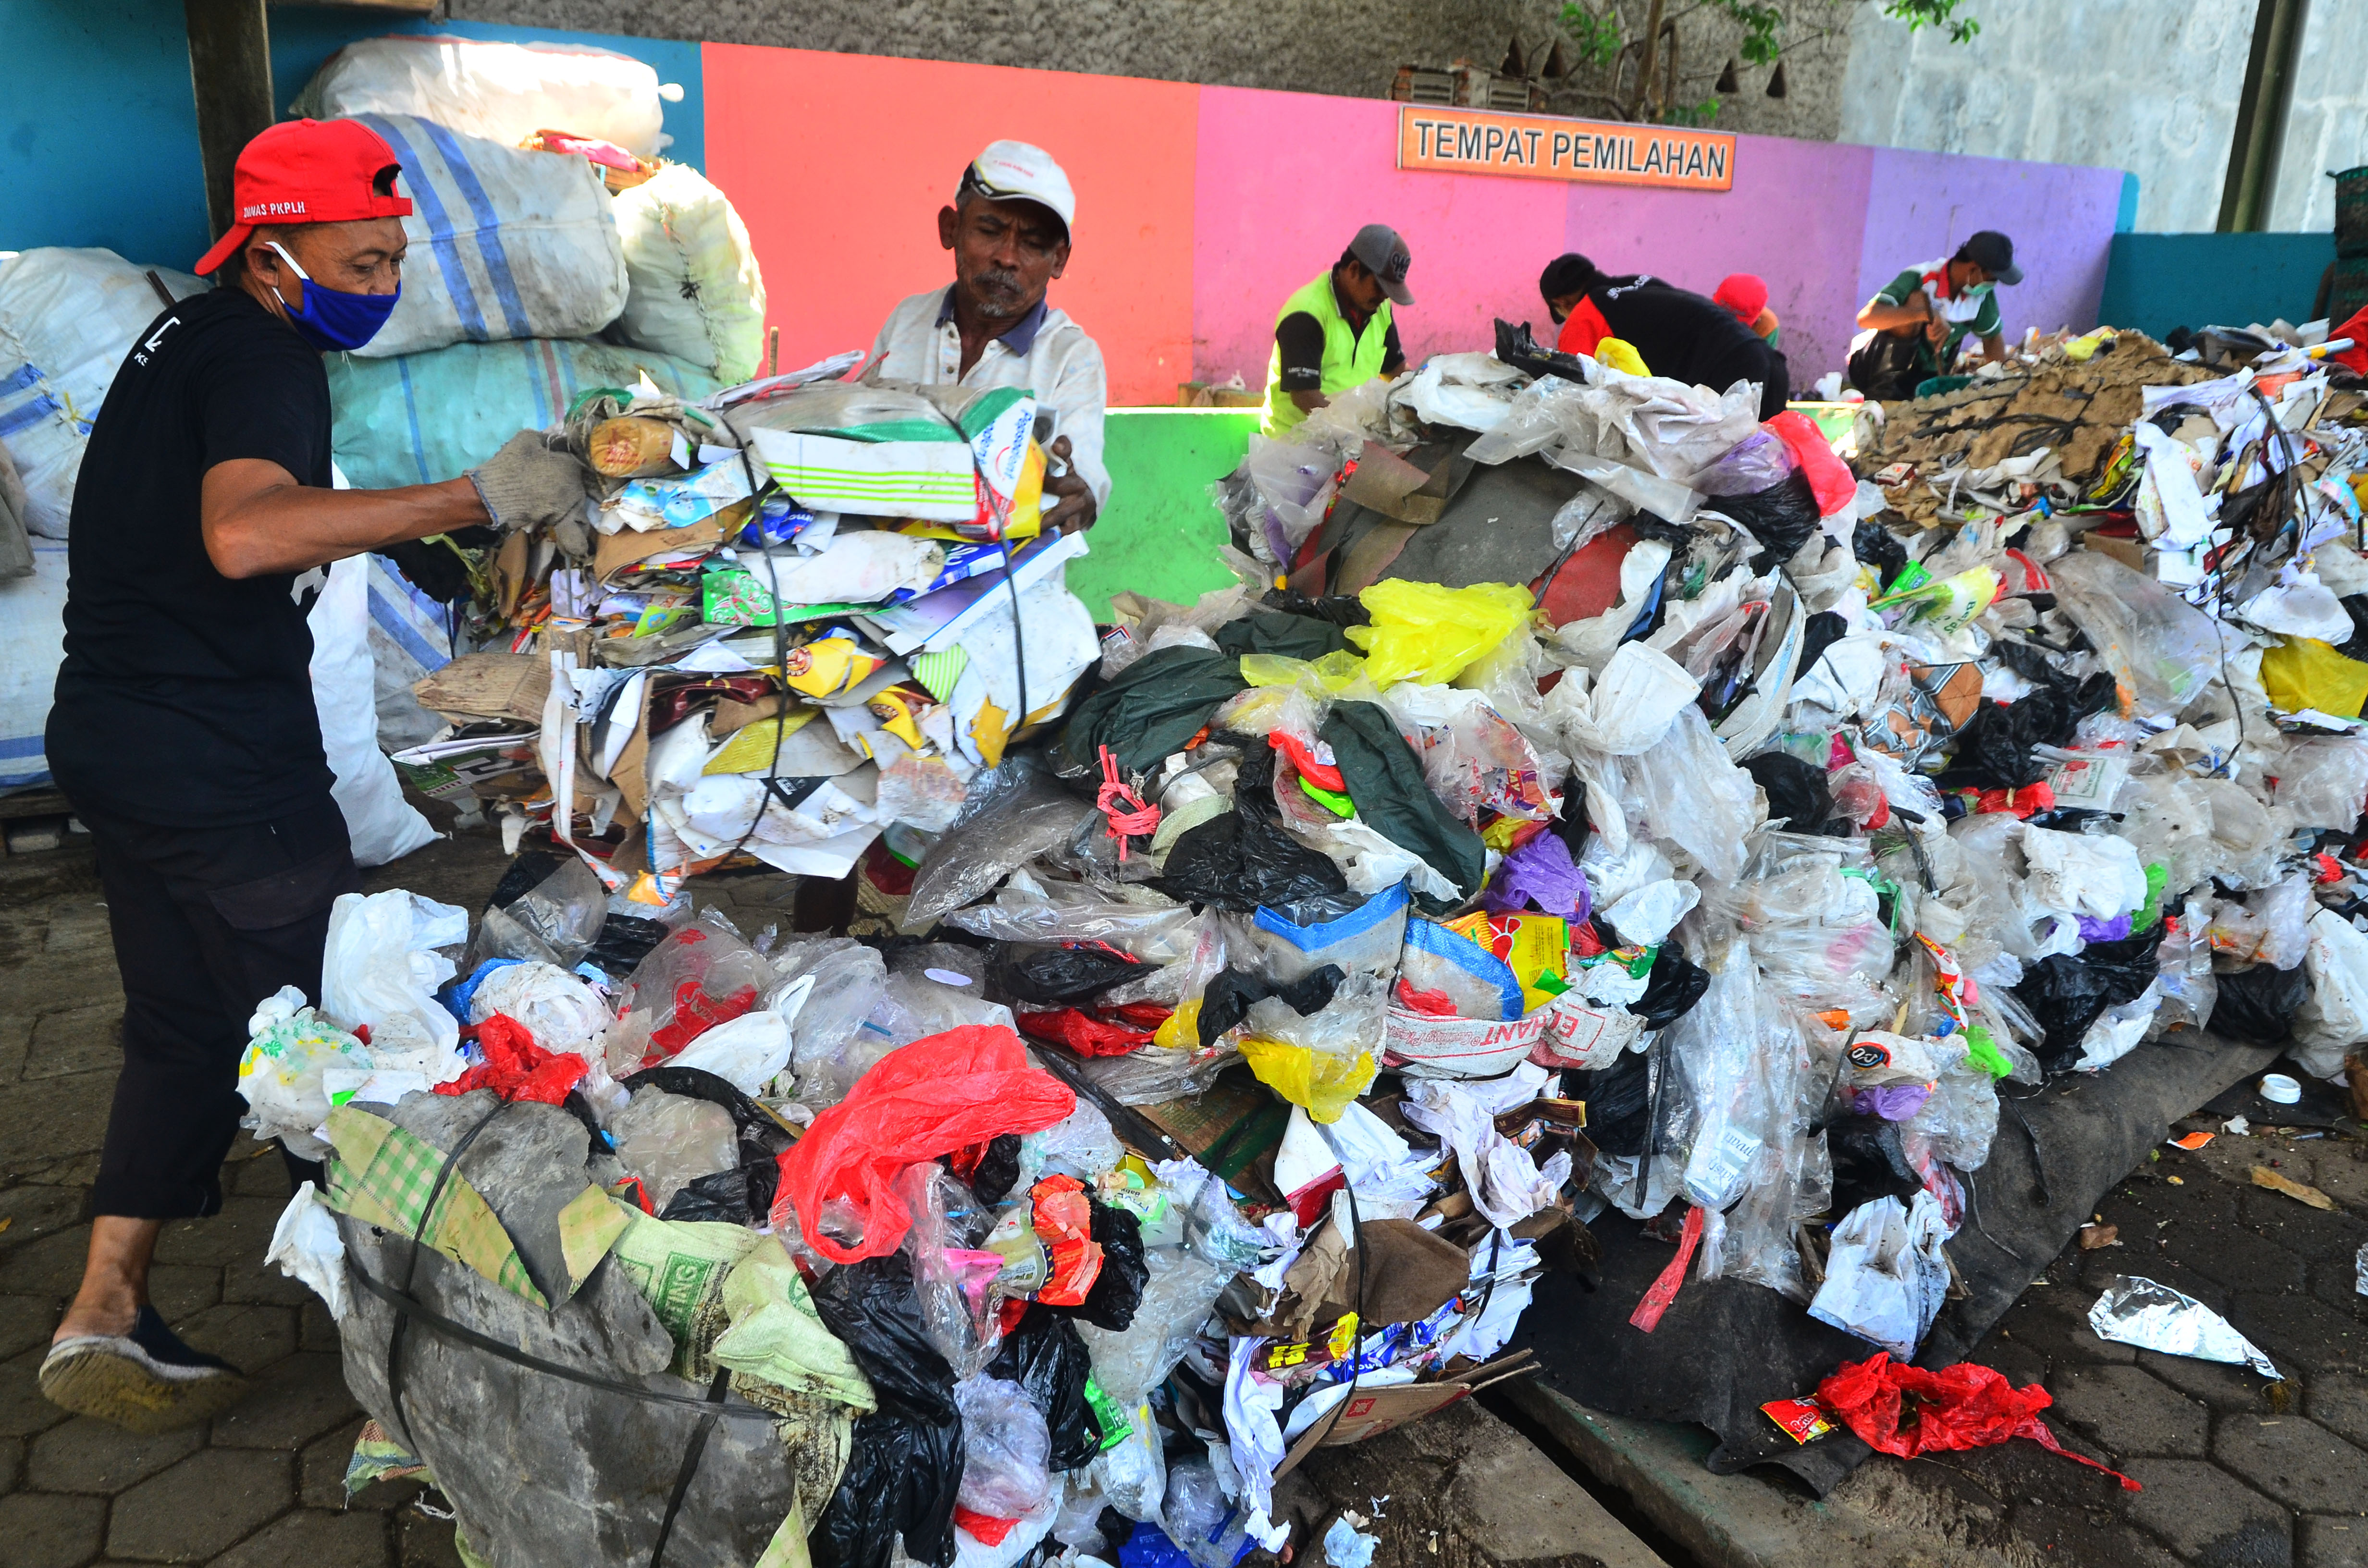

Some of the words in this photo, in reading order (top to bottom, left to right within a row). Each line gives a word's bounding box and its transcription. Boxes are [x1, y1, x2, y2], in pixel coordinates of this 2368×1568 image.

[1415, 120, 1543, 164] TEMPAT
[1553, 132, 1726, 178] PEMILAHAN
[244, 204, 267, 218] DINAS
[270, 201, 306, 215] PKPLH
